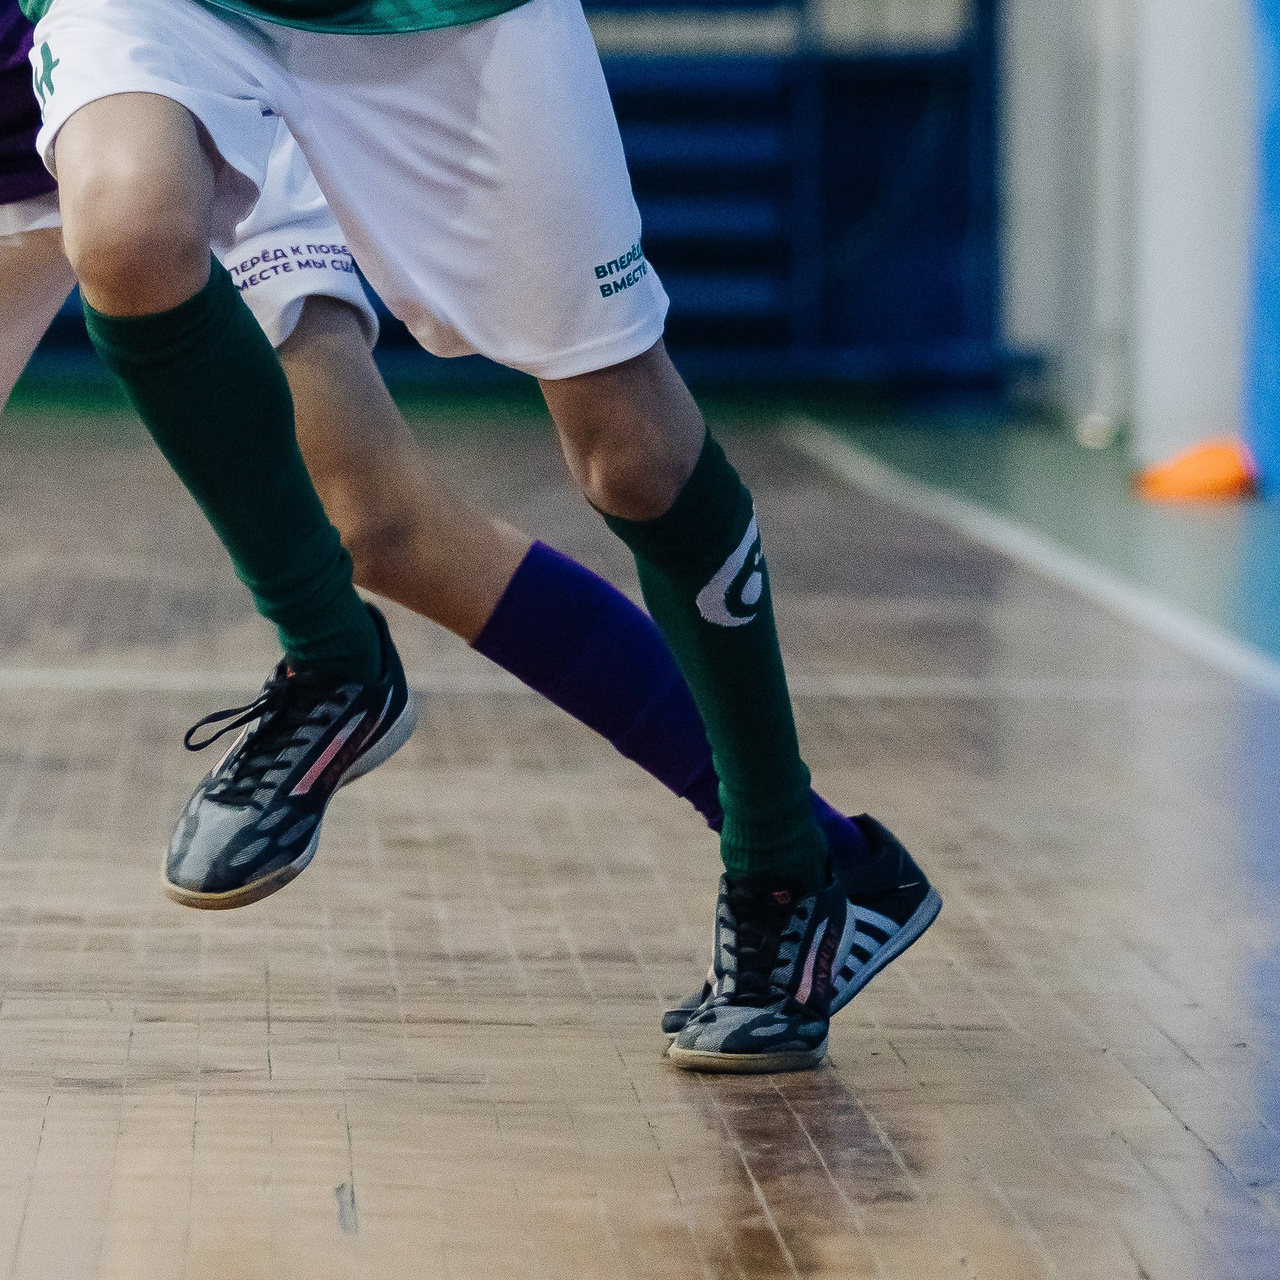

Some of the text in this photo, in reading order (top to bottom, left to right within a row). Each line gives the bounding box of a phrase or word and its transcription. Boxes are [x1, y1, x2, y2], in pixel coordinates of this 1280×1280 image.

[229, 244, 352, 277] ПЕРЁД К ПОБЕ
[233, 261, 294, 291] МЕСТЕ
[296, 258, 327, 271] МЫ
